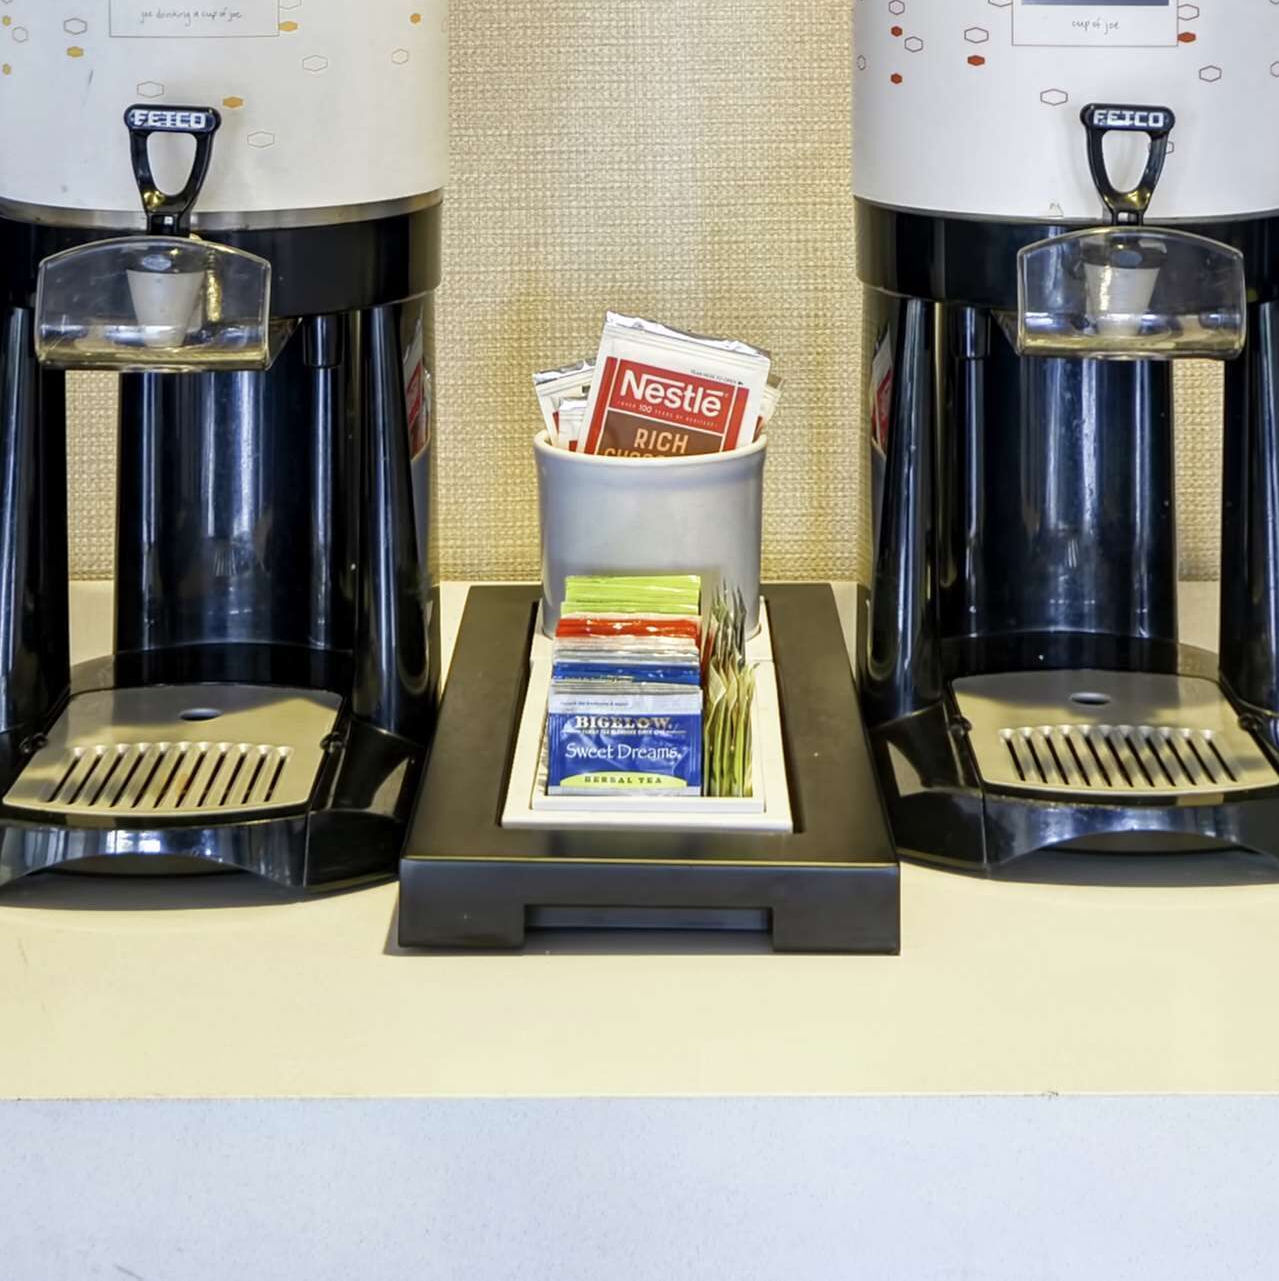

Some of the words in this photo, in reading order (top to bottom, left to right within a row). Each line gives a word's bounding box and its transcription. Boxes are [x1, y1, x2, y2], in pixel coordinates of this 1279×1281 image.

[1072, 20, 1090, 31] cup
[134, 109, 207, 128] FETCO
[1093, 109, 1165, 127] FETCO
[639, 403, 653, 414] 100
[633, 427, 689, 455] RICH
[565, 742, 614, 759] Sweet
[584, 775, 633, 784] HERBAL
[639, 776, 663, 784] TEA
